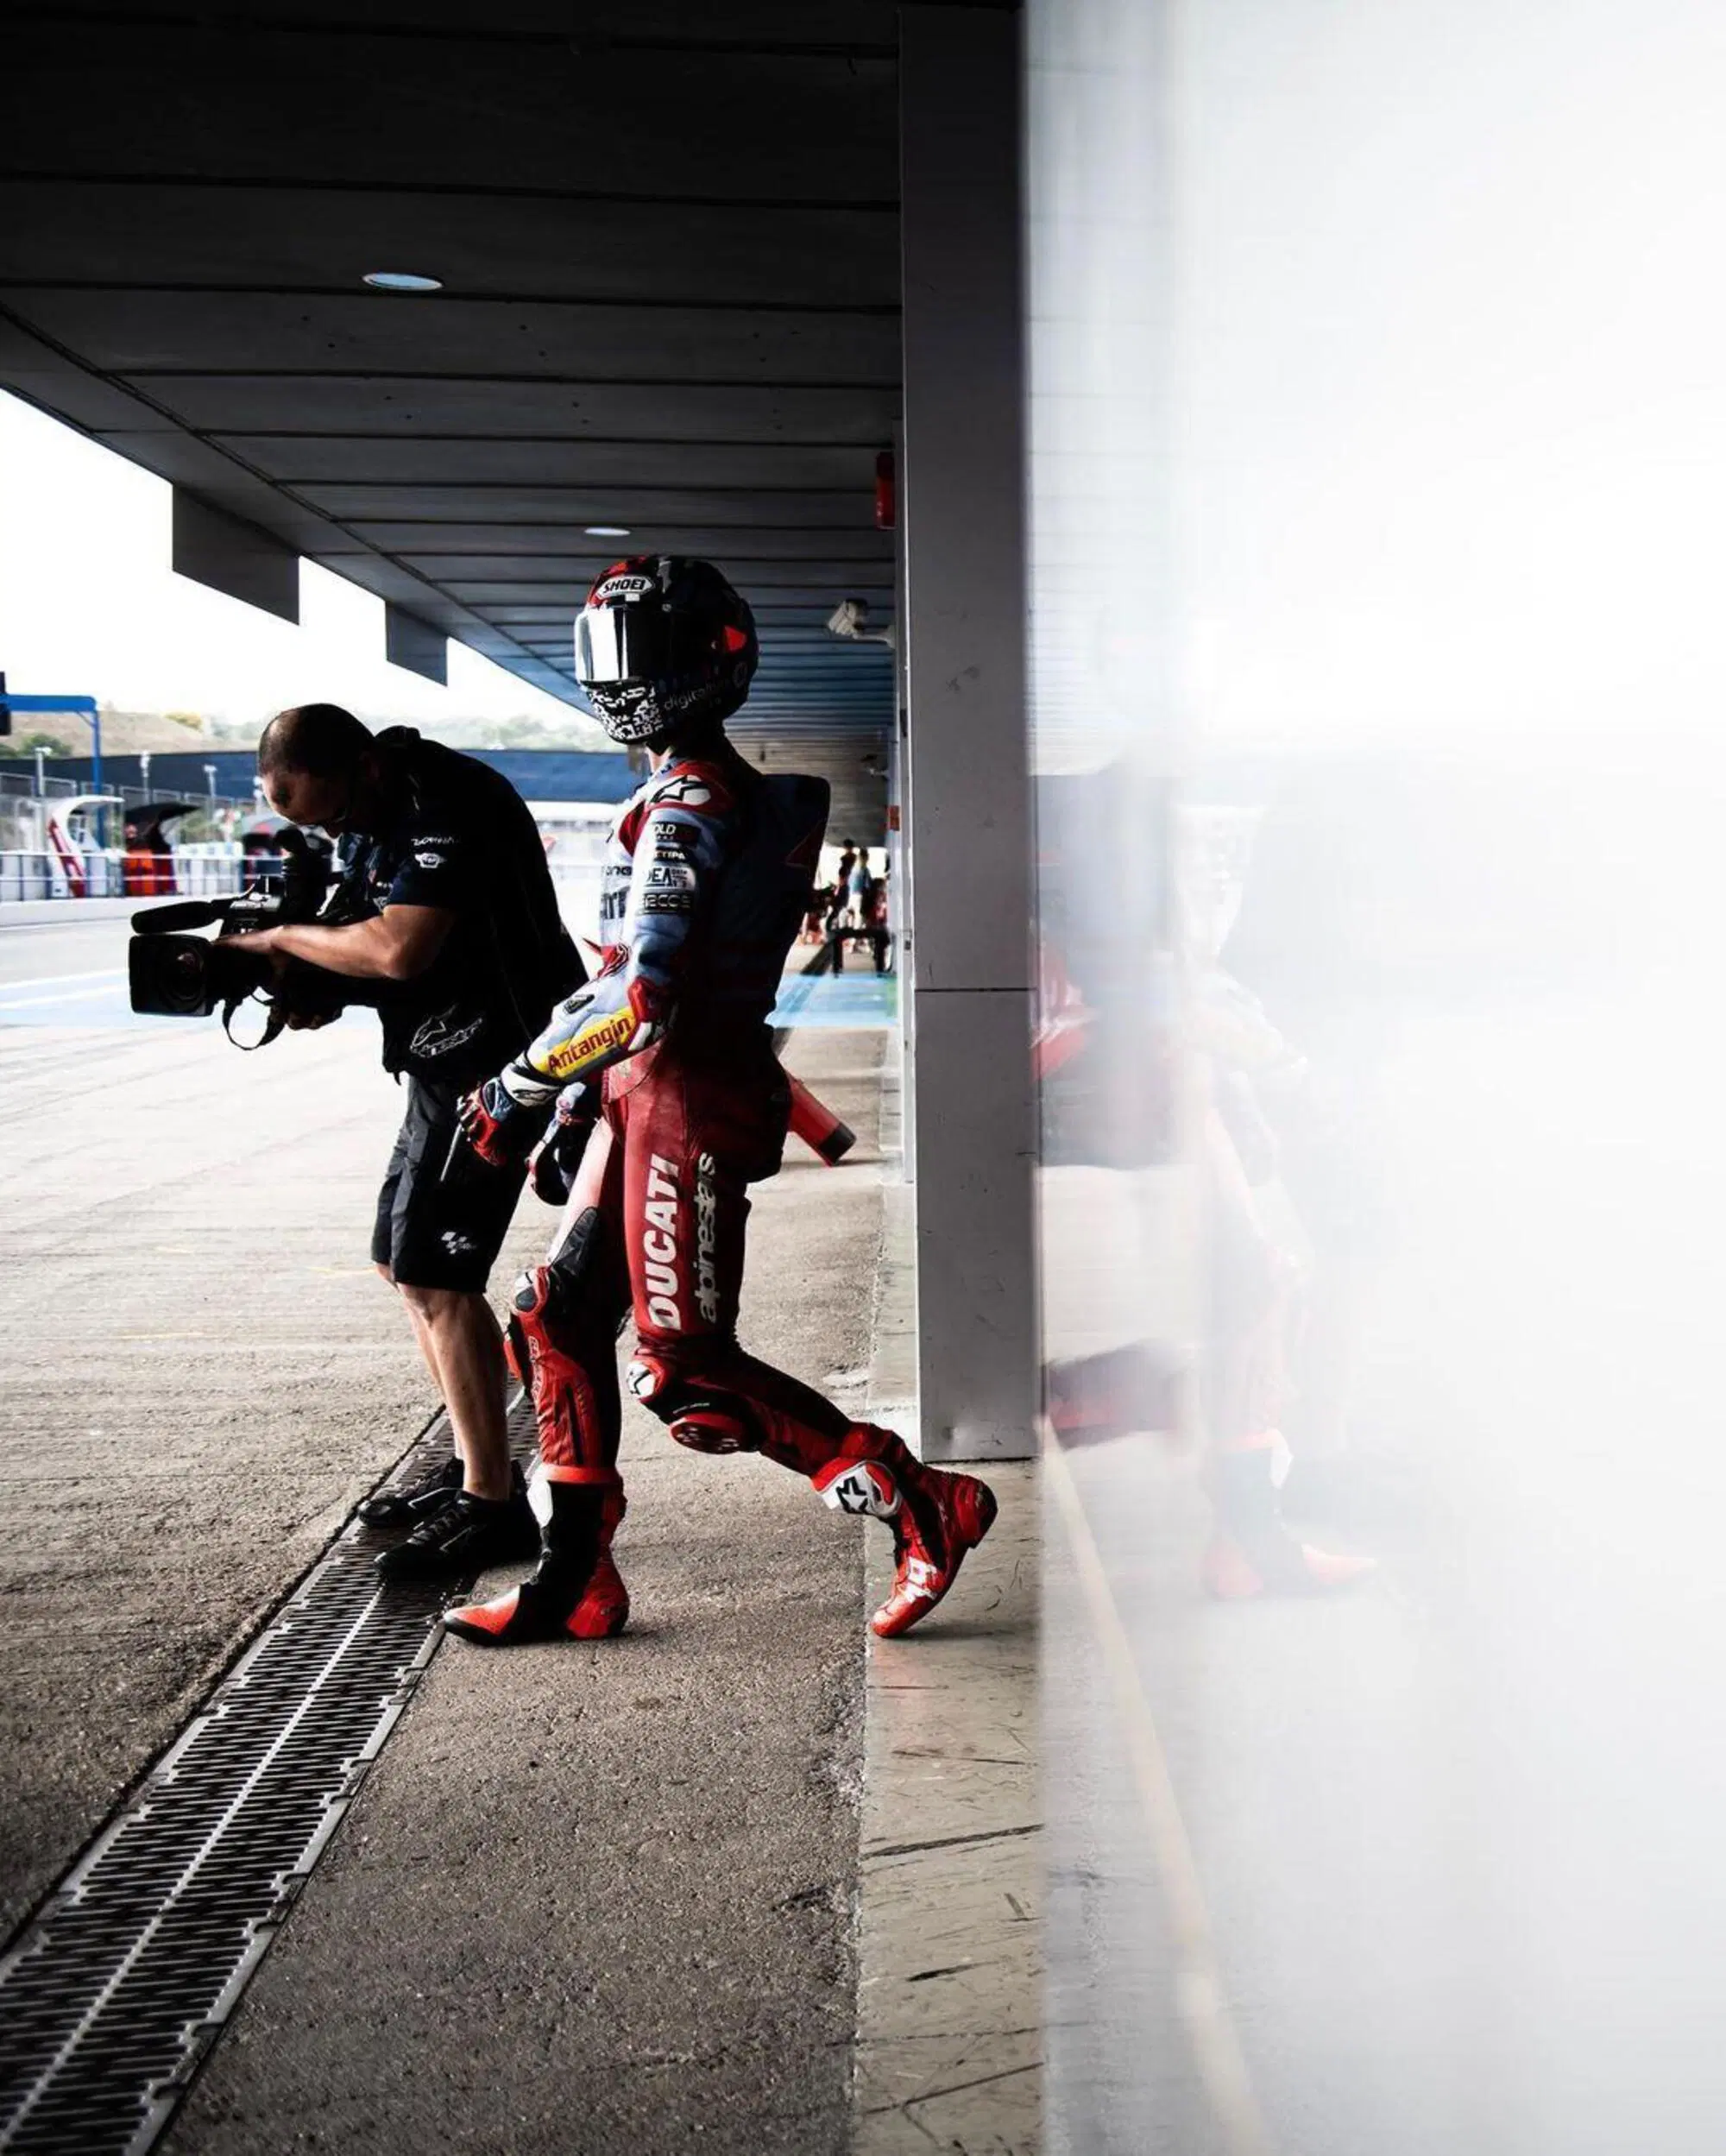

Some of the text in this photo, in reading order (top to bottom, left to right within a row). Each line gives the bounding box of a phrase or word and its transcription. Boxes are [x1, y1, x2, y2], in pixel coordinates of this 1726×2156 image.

[603, 578, 646, 594] SHOEI
[546, 1014, 633, 1074] Antangin
[642, 1153, 683, 1331] DUCATI
